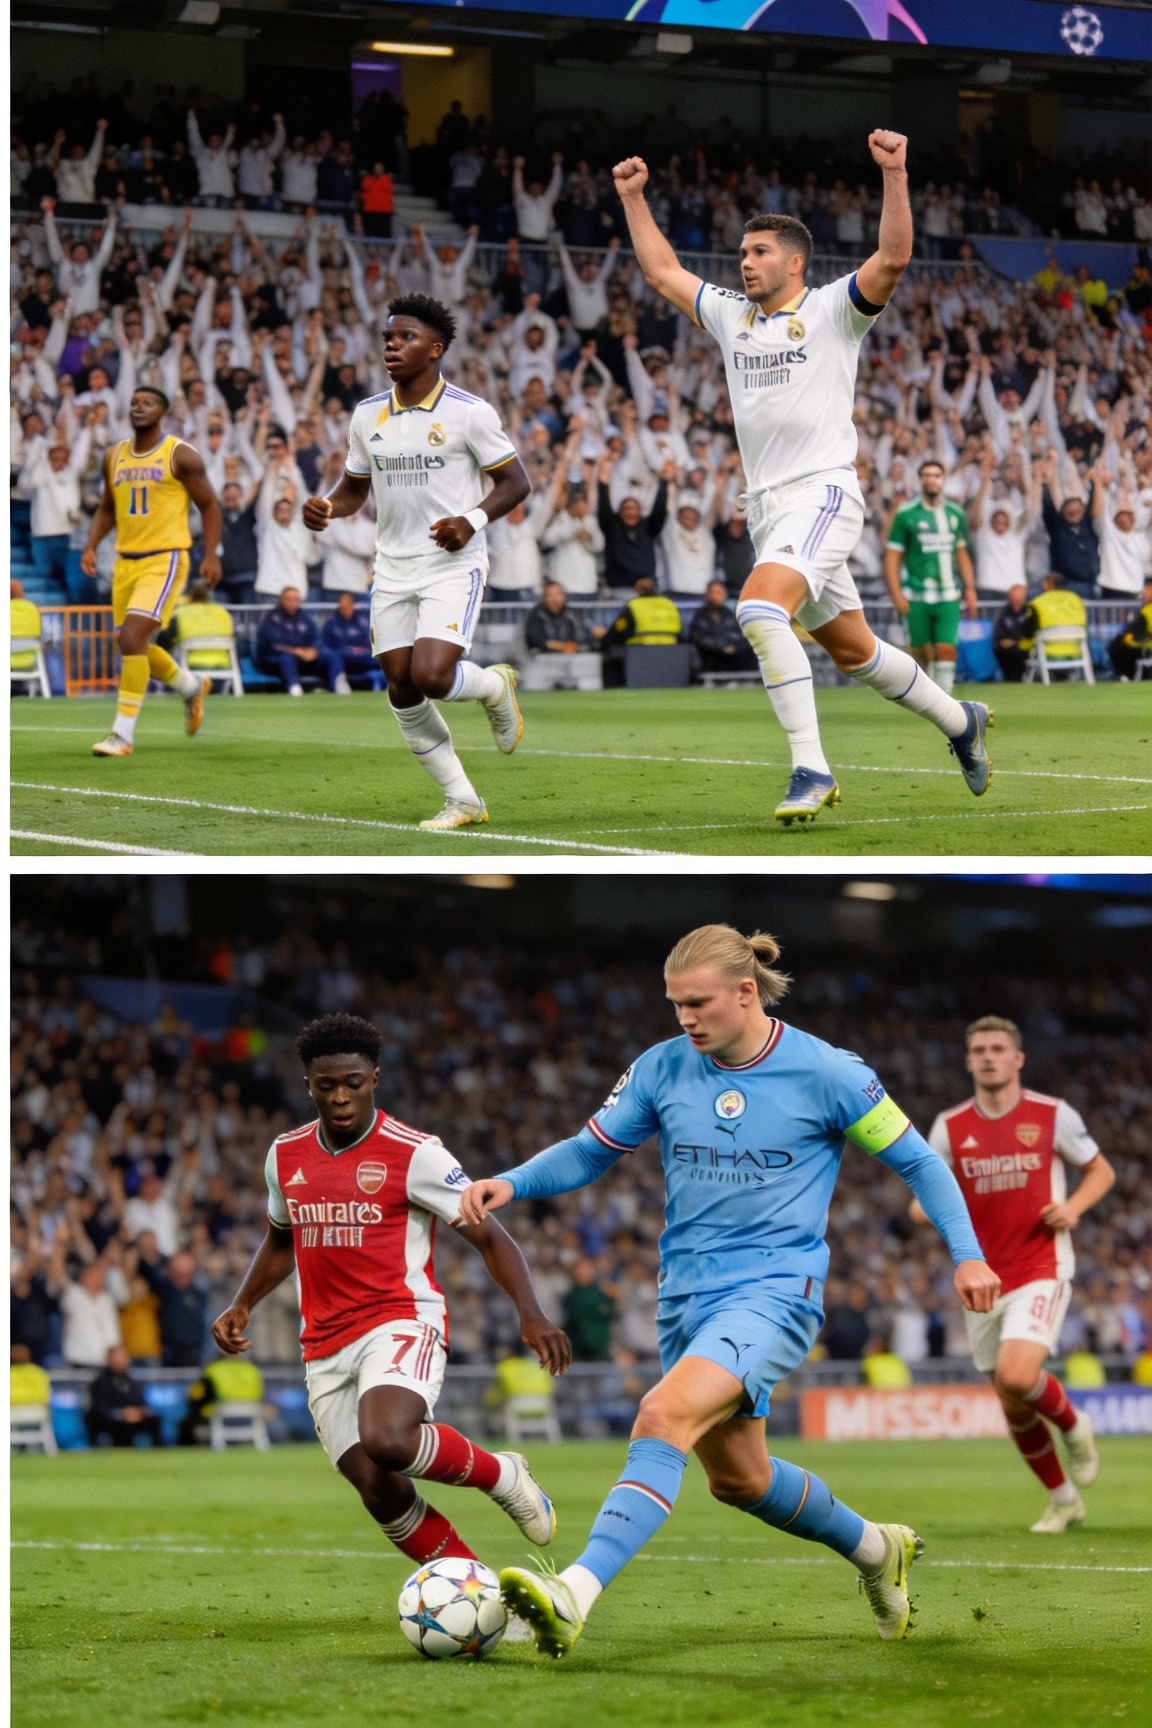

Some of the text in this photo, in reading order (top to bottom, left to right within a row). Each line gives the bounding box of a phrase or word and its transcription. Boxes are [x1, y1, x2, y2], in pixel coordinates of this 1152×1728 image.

[129, 486, 149, 515] 11
[673, 1142, 793, 1170] ETIHAD
[286, 1196, 383, 1225] Emirates
[391, 1333, 418, 1365] 7
